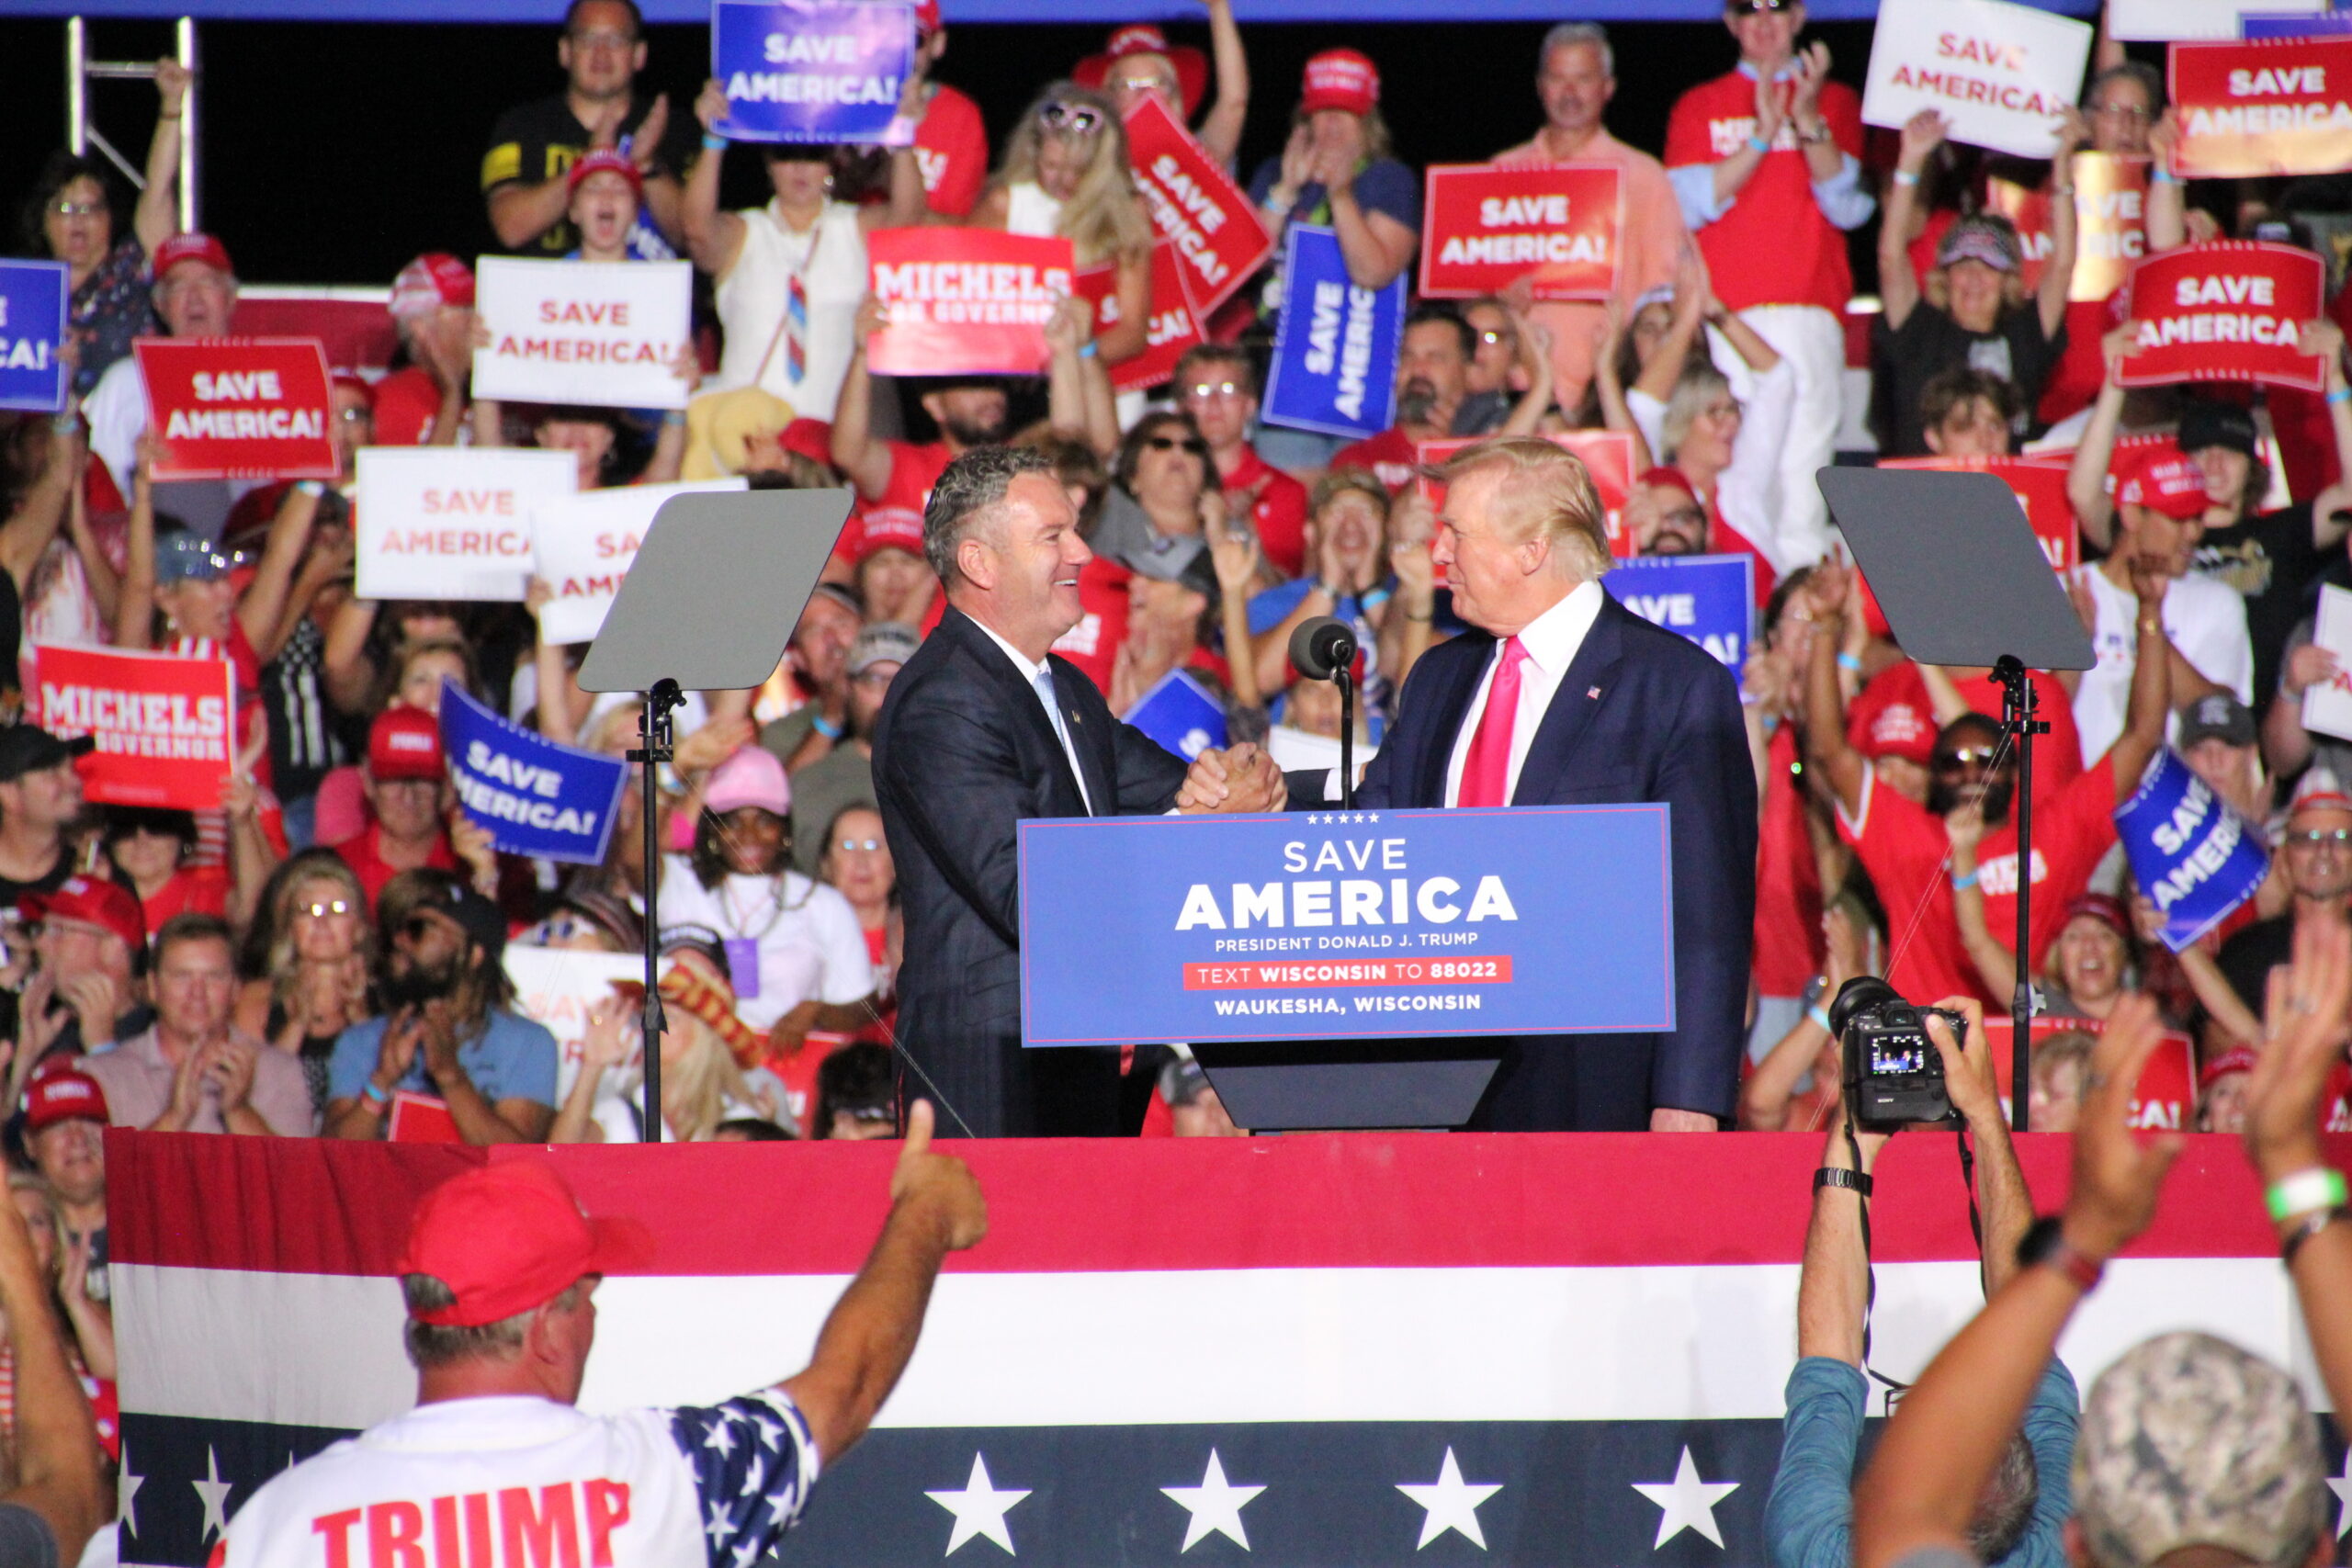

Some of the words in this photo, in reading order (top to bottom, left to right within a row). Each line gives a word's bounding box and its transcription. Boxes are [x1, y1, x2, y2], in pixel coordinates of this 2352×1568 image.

[764, 32, 856, 63] SAVE
[1937, 31, 2028, 71] SAVE
[727, 71, 898, 105] AMERICA!
[1892, 63, 2058, 116] AMERICA
[2229, 66, 2326, 96] SAVE
[2187, 101, 2352, 136] AMERICA
[1151, 153, 1227, 236] SAVE
[1480, 195, 1569, 227] SAVE
[1440, 233, 1607, 265] AMERICA!
[875, 261, 1071, 303] MICHELS
[2176, 276, 2276, 306] SAVE
[538, 299, 629, 326] SAVE
[1305, 280, 1344, 376] SAVE
[2137, 313, 2299, 347] AMERICA
[1334, 285, 1376, 422] AMERIC
[192, 371, 283, 401] SAVE
[165, 408, 322, 440] AMERICA!
[423, 490, 515, 515] SAVE
[381, 529, 530, 556] AMERIC
[41, 682, 223, 737] MICHELS
[95, 731, 226, 761] GOVERNOR
[467, 740, 563, 799] SAVE
[1283, 838, 1408, 874] SAVE
[1174, 875, 1519, 931] AMERICA
[1215, 937, 1312, 952] PRESIDENT
[1318, 934, 1393, 949] DONALD
[1398, 934, 1413, 947] J.
[1419, 932, 1478, 946] TRUMP
[1197, 967, 1251, 984] TEXT
[1259, 964, 1386, 983] WISCONSIN
[1394, 964, 1422, 979] TO
[1430, 962, 1498, 978] 88022
[1214, 998, 1346, 1015] WAUKESHA,
[1353, 994, 1481, 1012] WISCONSIN
[311, 1477, 630, 1568] TRUMP
